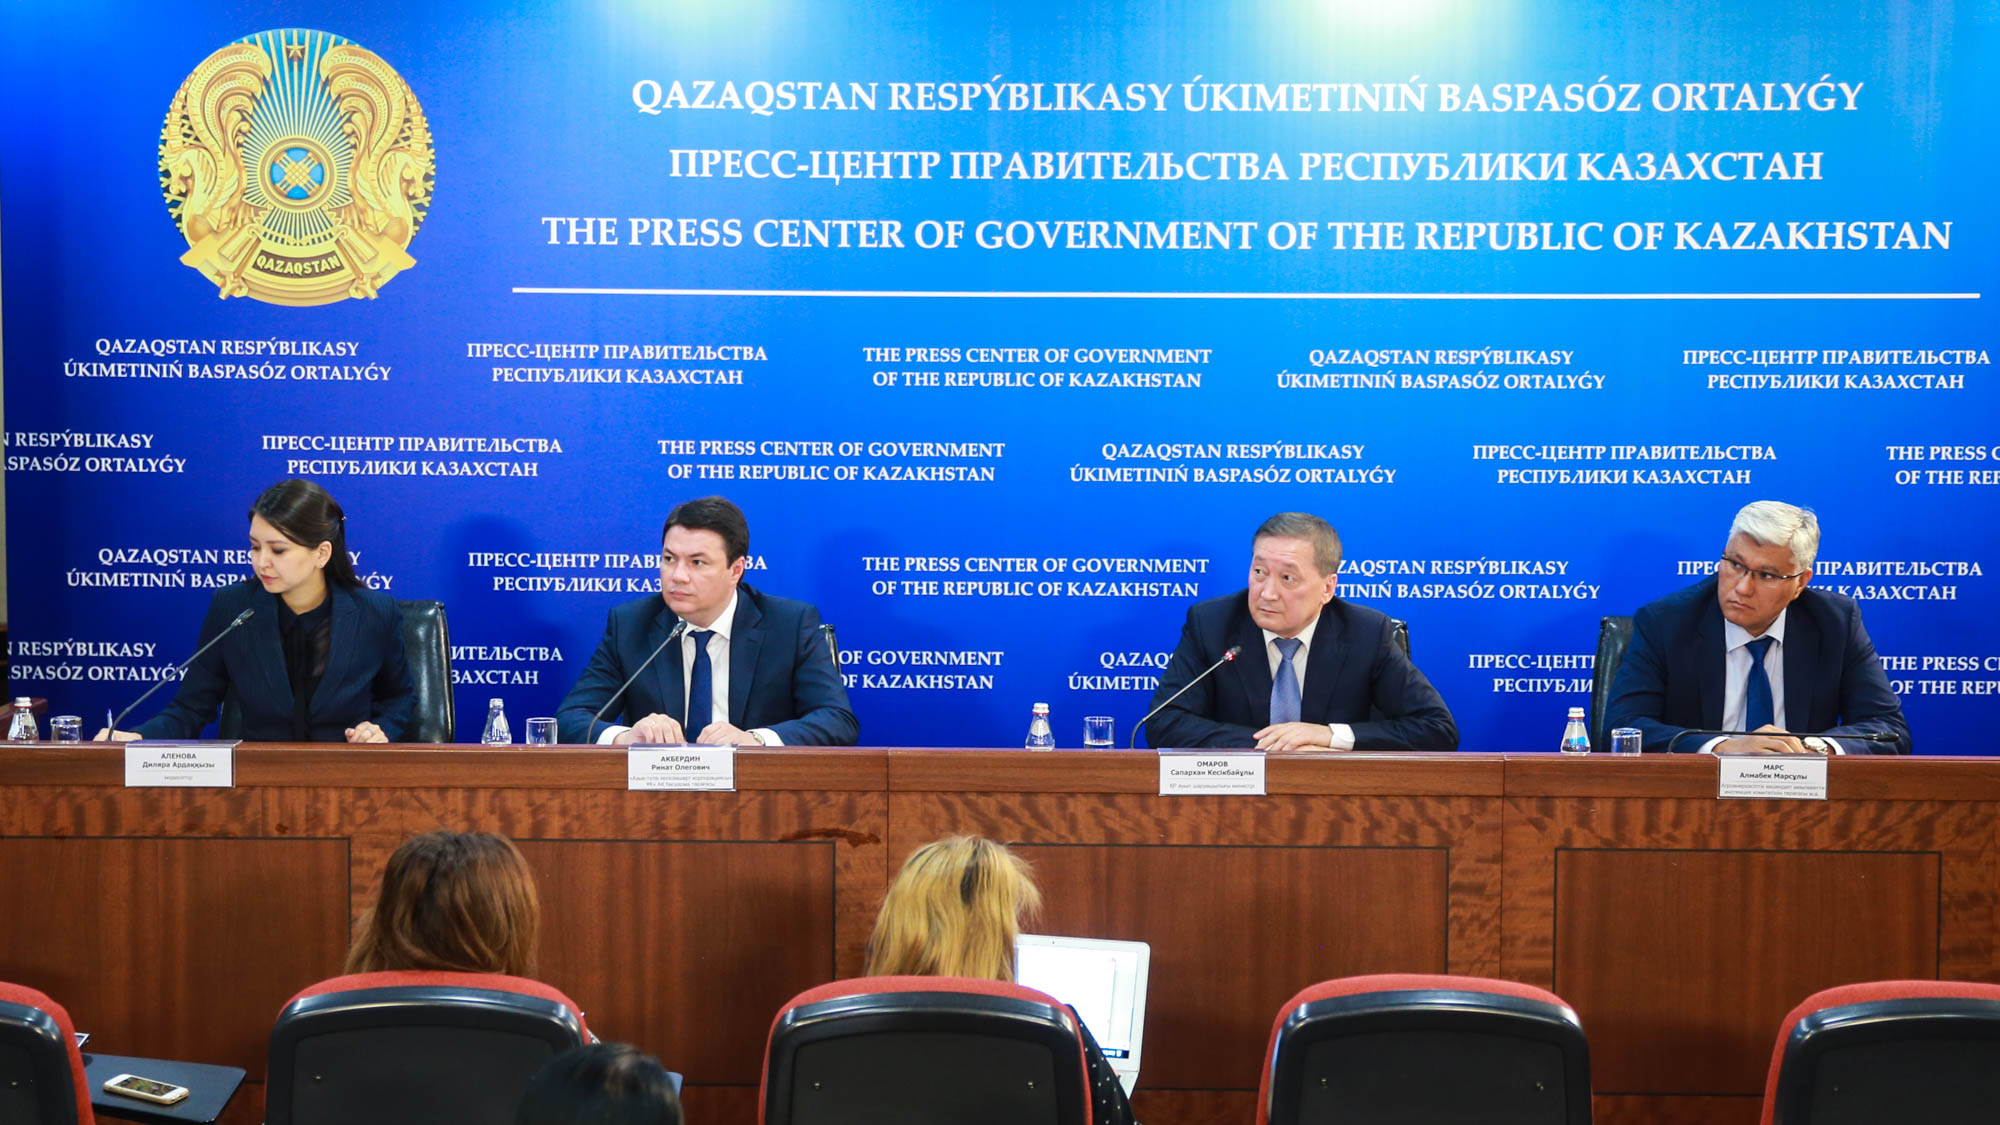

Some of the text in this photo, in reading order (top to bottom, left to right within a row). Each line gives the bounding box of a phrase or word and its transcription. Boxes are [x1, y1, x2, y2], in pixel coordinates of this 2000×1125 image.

[631, 72, 1865, 117] QAZAQSTAN RESPÝBLIKASY ÚKIMETINIŃ BASPASÓZ ORTALYǴY
[668, 148, 1825, 187] ПРЕСС-ЦЕНТР ПРАВИТЕЛЬСТВА РЕСПУБЛИКИ КАЗАХСТАН
[541, 216, 1954, 252] THE PRESS CENTER OF GOVERNMENT OF THE REPUBLIC OF KAZAKHSTAN
[256, 254, 341, 277] QAZAQSTAN
[95, 336, 360, 358] QAZAQSTAN RESPÝBLIKASY
[466, 343, 769, 362] ПРЕСС-ЦЕНТР ПРАВИТЕЛЬСТВА
[862, 346, 1213, 364] THE PRESS CENTER OF GOVERNMENT
[1308, 345, 1574, 368] QAZAQSTAN RESPÝBLIKASY
[1682, 349, 1991, 368] ПРЕСС-ЦЕНТР ПРАВИТЕЛЬСТВА
[63, 358, 392, 381] ÚKIMETINIŃ BASPASÓZ ORTALYǴY
[492, 367, 744, 385] РЕСПУБЛИКИ КАЗАХСТАН
[1276, 368, 1606, 390] ÚKIMETINIŃ BASPASÓZ ORTALYǴY
[872, 370, 1203, 389] OF THE REPUBLIC OF KAZAKHSTAN
[1707, 373, 1965, 390] РЕСПУБЛИКИ КАЗАХСТАН
[14, 428, 155, 449] RESPÝBLIKASY
[261, 434, 563, 454] ПРЕСС-ЦЕНТР ПРАВИТЕЛЬСТВА
[657, 439, 1006, 458] THE PRESS CENTER OF GOVERNMENT
[1101, 439, 1365, 462] QAZAQSTAN RESPÝBLIKASY
[1472, 444, 1777, 463] ПРЕСС-ЦЕНТР ПРАВИТЕЛЬСТВА
[1885, 445, 1925, 461] THE
[1929, 445, 1987, 461] PRESS
[3, 452, 187, 474] SPASÓZ ORTALYǴY
[287, 459, 539, 477] РЕСПУБЛИКИ КАЗАХСТАН
[667, 463, 996, 482] OF THE REPUBLIC OF KAZAKHSTAN
[1069, 463, 1397, 484] ÚKIMETINIŃ BASPASÓZ ORTALYǴY
[1496, 468, 1752, 485] РЕСПУБЛИКИ КАЗАХСТАН
[1894, 469, 1922, 486] OF
[1924, 469, 1964, 485] THE
[98, 548, 219, 567] QAZAQSTAN
[468, 552, 601, 571] ПРЕСС-ЦЕНТР
[861, 556, 1210, 574] THE PRESS CENTER OF GOVERNMENT
[1333, 556, 1569, 579] ZAQSTAN RESPÝBLIKASY
[1815, 561, 1983, 577] ПРАВИТЕЛЬСТВА
[66, 567, 186, 588] ÚKIMETINIŃ
[493, 576, 622, 593] РЕСПУБЛИКИ
[871, 580, 1199, 598] OF THE REPUBLIC OF KAZAKHSTAN
[1334, 578, 1601, 600] TINIŃ BASPASÓZ ORTALYǴY
[17, 637, 158, 659] RESPÝBLIKASY
[451, 645, 564, 662] ИТЕЛЬСТВА
[837, 649, 1005, 666] OF GOVERNMENT
[1099, 651, 1174, 670] QAZAQ
[1878, 655, 1918, 671] THE
[1921, 656, 1980, 672] PRESS
[7, 660, 85, 681] SPASÓZ
[451, 669, 539, 685] ЗАХСТАН
[862, 674, 994, 690] KAZAKHSTAN
[1067, 671, 1160, 691] ÚKIMETIN
[1492, 677, 1594, 693] РЕСПУБЛИ
[1889, 679, 1915, 695] OF
[1917, 680, 1957, 695] THE
[142, 761, 171, 769] Диляра
[1170, 769, 1206, 777] Сапархан
